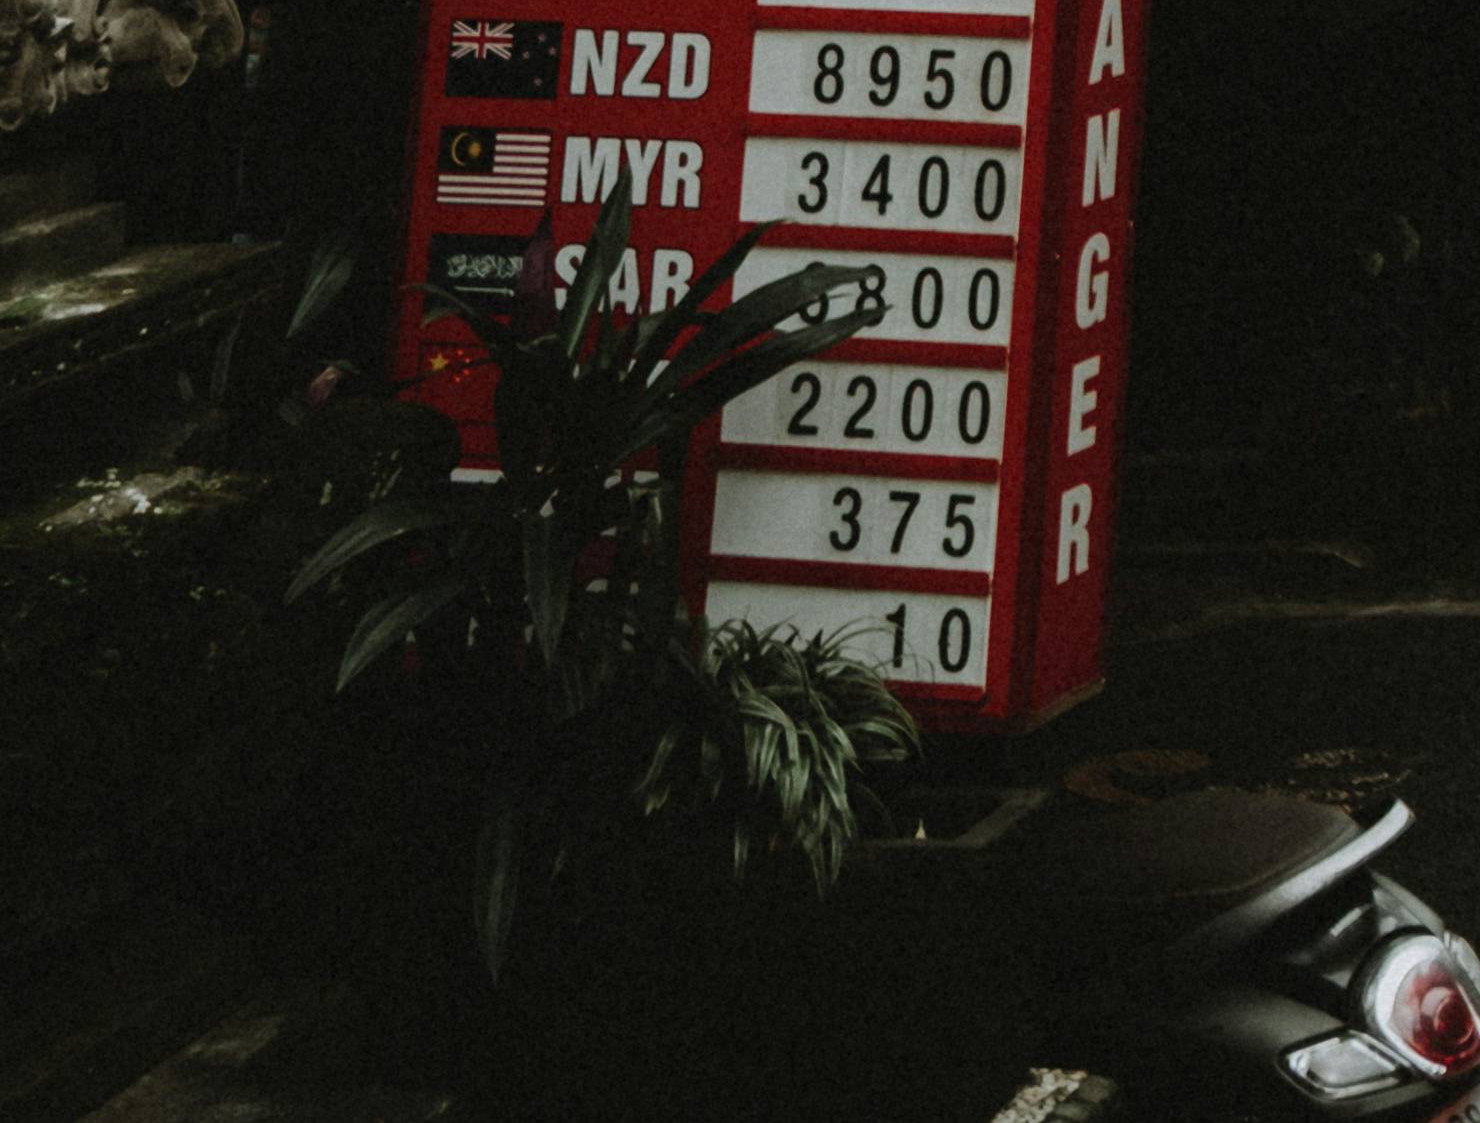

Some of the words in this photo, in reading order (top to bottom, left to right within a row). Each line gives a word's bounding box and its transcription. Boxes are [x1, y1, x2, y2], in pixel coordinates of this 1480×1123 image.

[568, 29, 713, 102] NZD
[814, 42, 1013, 112] 8950
[560, 134, 704, 210] MYR
[798, 150, 1007, 222] 3400
[787, 372, 992, 445] 2200
[829, 487, 976, 560] 375
[886, 603, 971, 673] 10
